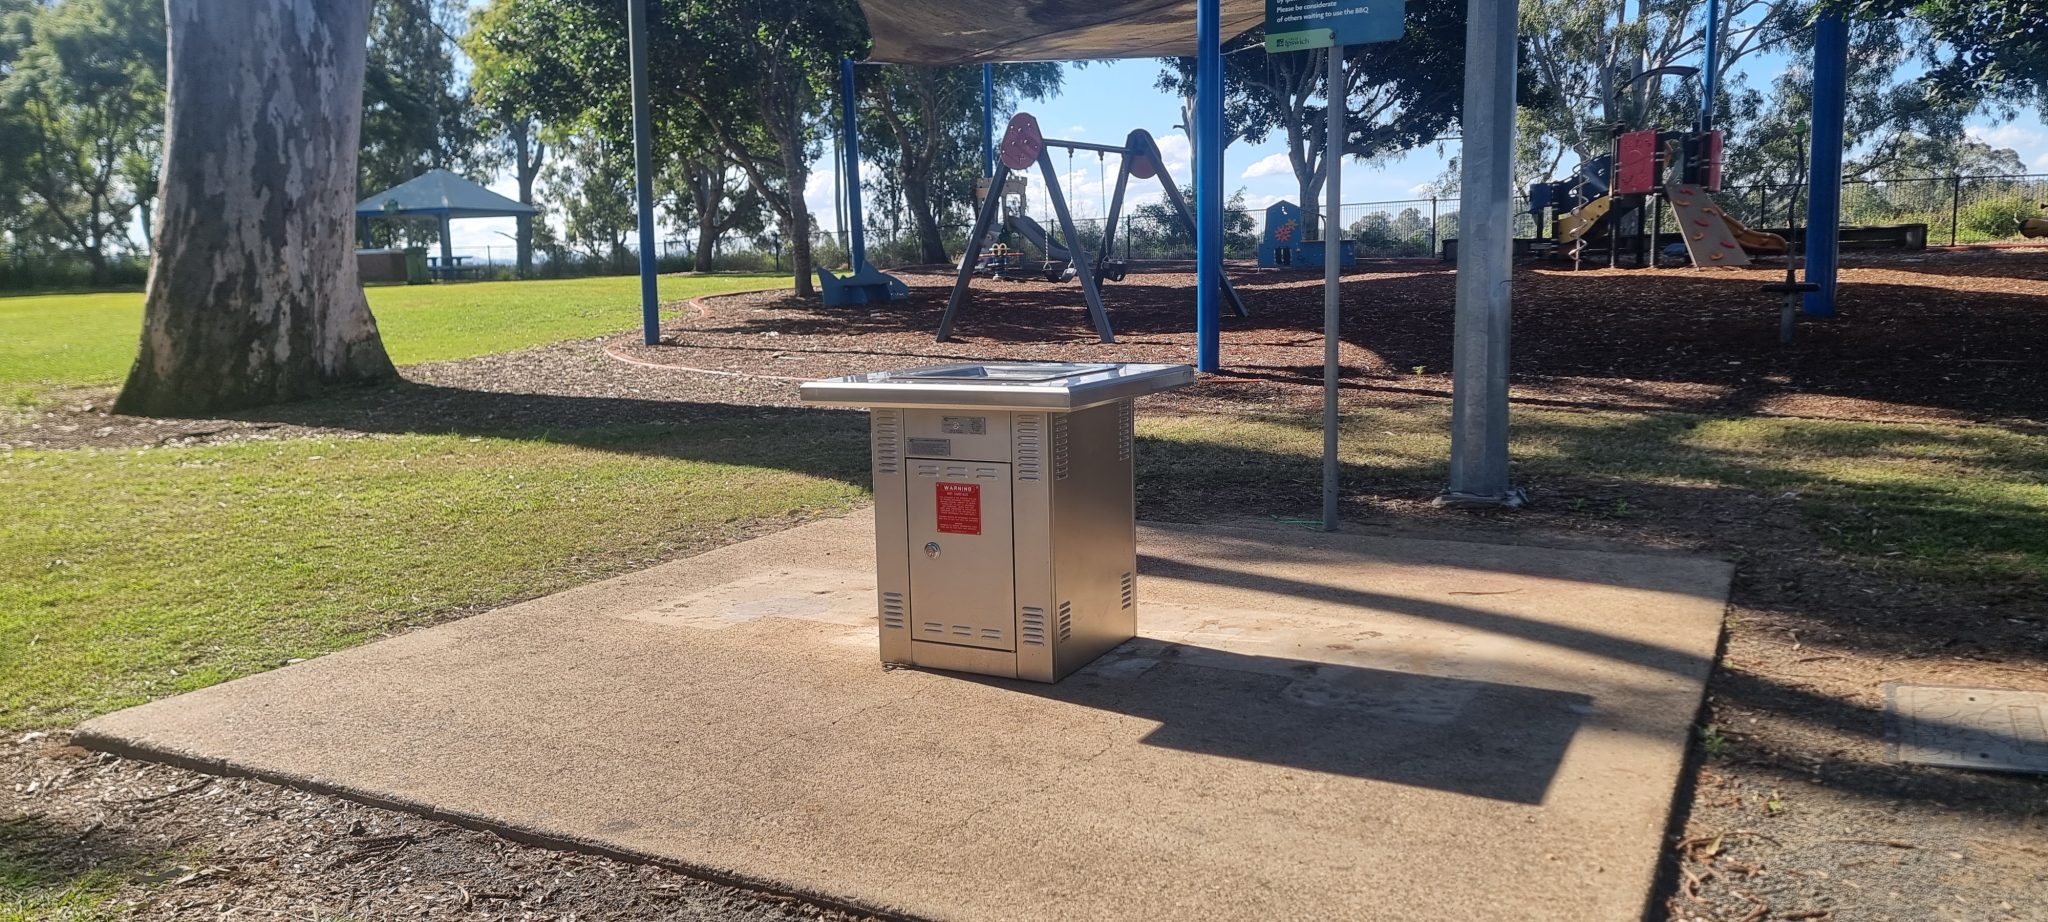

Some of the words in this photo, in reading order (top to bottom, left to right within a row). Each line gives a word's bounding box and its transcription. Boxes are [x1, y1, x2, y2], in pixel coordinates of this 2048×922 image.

[1303, 1, 1337, 10] considerate
[1283, 14, 1302, 22] others
[1303, 12, 1325, 20] waiting
[1355, 6, 1369, 14] BBQ
[1285, 38, 1309, 48] Ipswich
